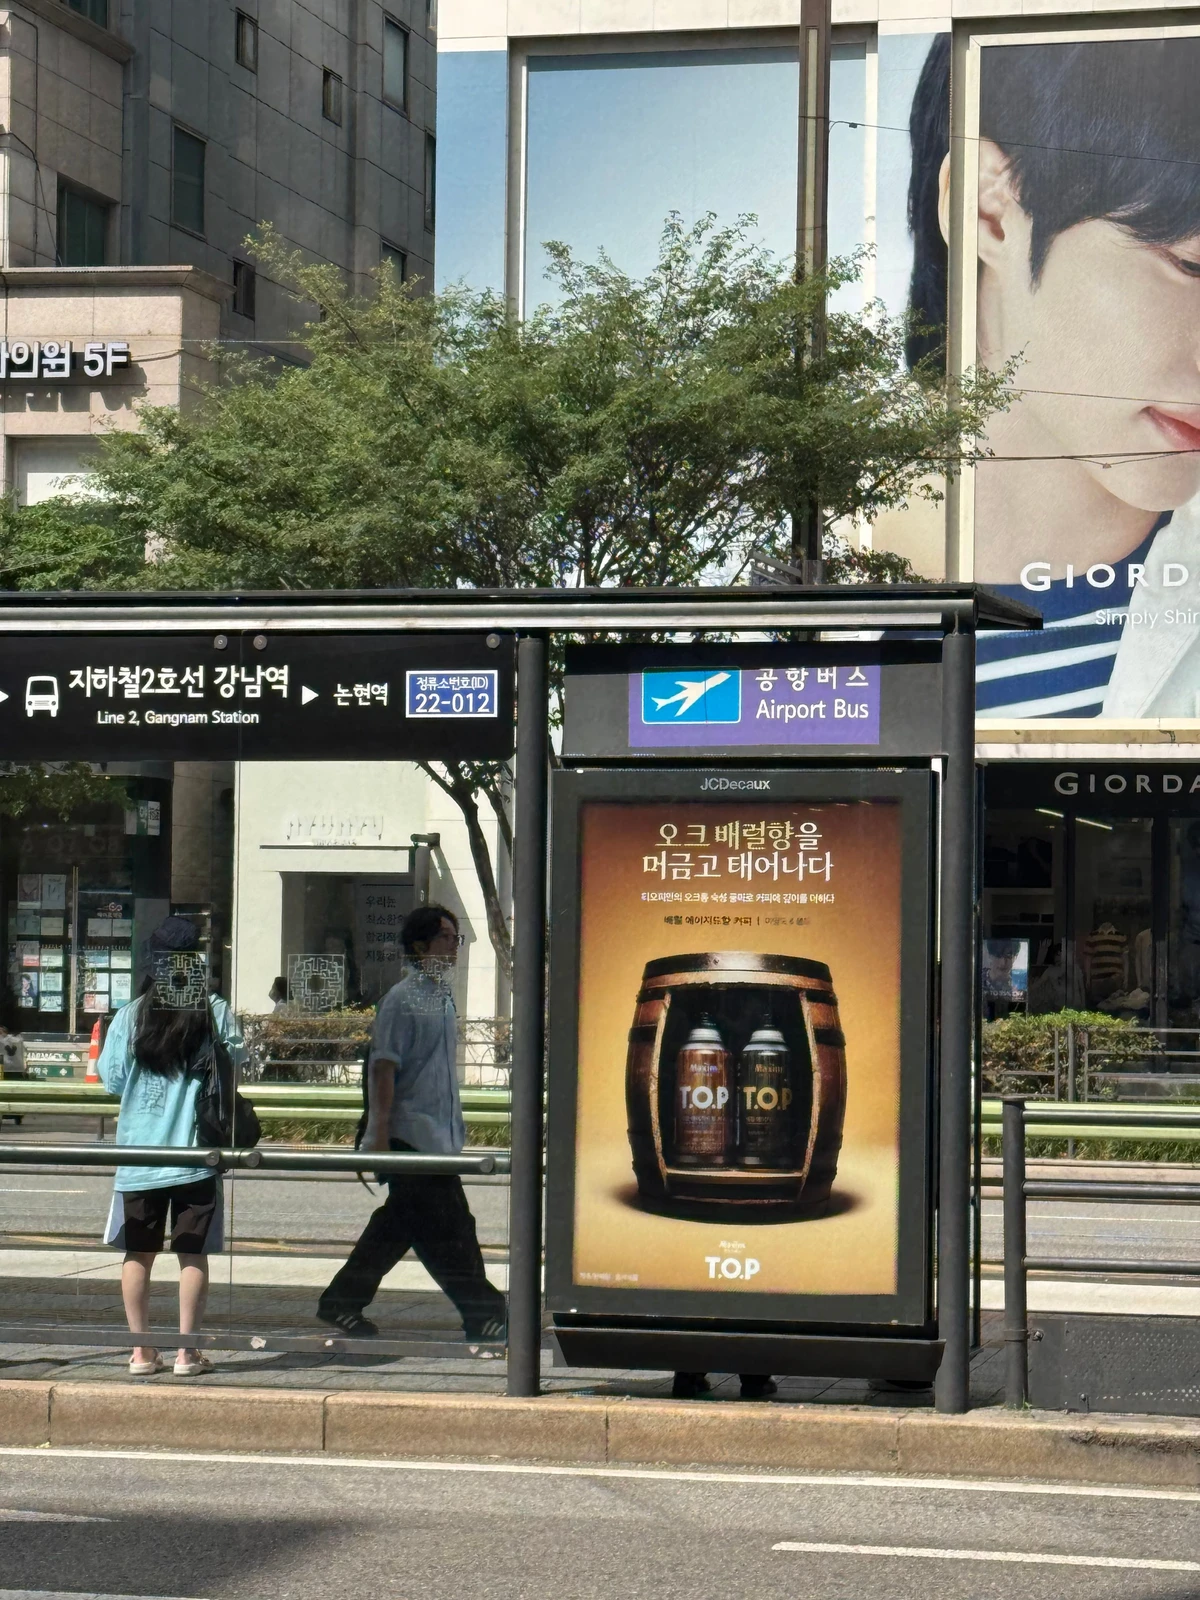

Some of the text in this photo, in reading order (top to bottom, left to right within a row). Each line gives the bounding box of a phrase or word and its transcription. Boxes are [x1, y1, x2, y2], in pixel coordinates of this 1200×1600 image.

[83, 342, 130, 377] 5F
[1020, 562, 1200, 592] GIORD
[1095, 608, 1159, 629] Simply
[68, 664, 289, 699] 지하철2호선 강남역
[333, 682, 389, 707] 논현역
[416, 676, 489, 691] 정류소번호(ID)
[415, 693, 490, 713] 22-012
[755, 698, 869, 724] Airport Bus
[97, 710, 260, 727] Line 2, Gangnam Station
[700, 777, 771, 791] JCDecaux
[655, 820, 823, 851] 오크 배럴향을
[642, 850, 835, 882] 머금고 태어나다
[679, 1085, 729, 1110] T.O.P
[742, 1085, 793, 1111] T.O.P
[704, 1255, 761, 1281] T.O.P
